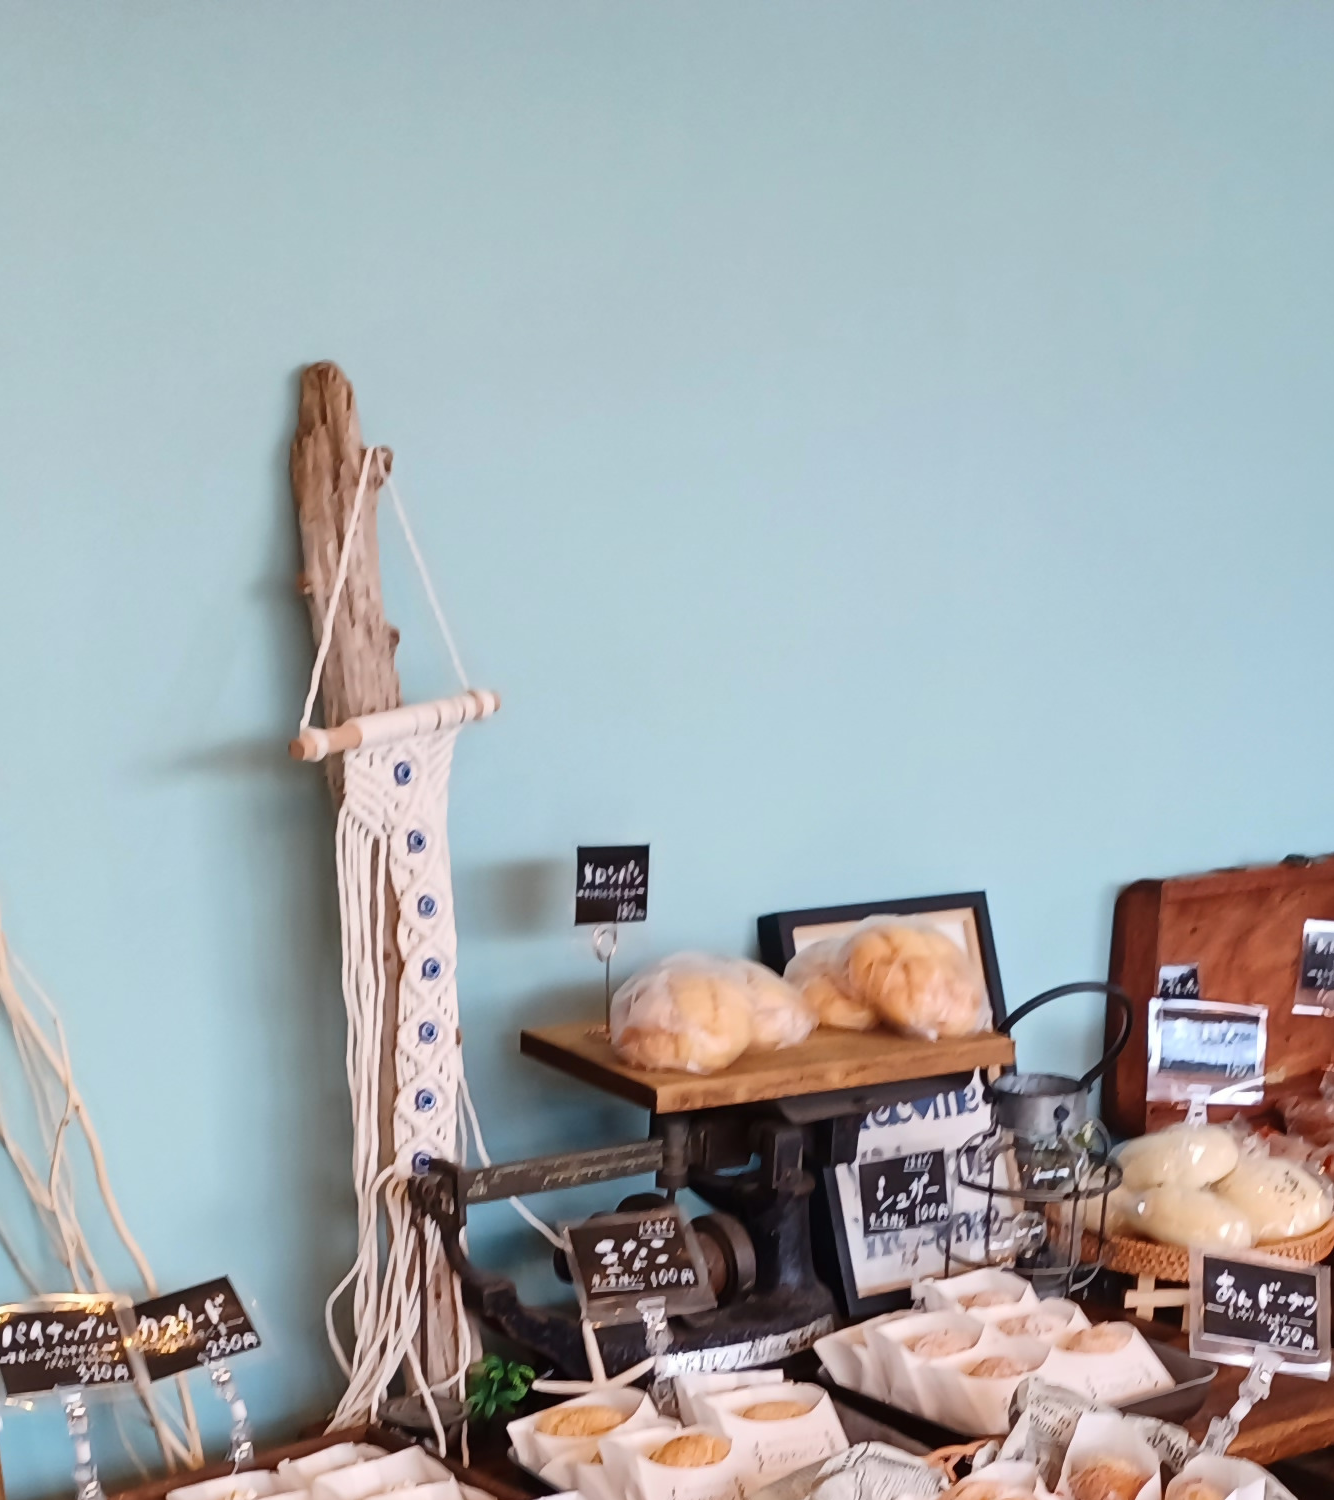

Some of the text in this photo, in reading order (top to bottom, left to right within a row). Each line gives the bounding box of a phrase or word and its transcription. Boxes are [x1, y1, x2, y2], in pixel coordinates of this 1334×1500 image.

[582, 860, 644, 887] メロンパン
[650, 1267, 695, 1288] 100円
[2, 1315, 118, 1348] パイナップル
[1268, 1323, 1315, 1351] 250円
